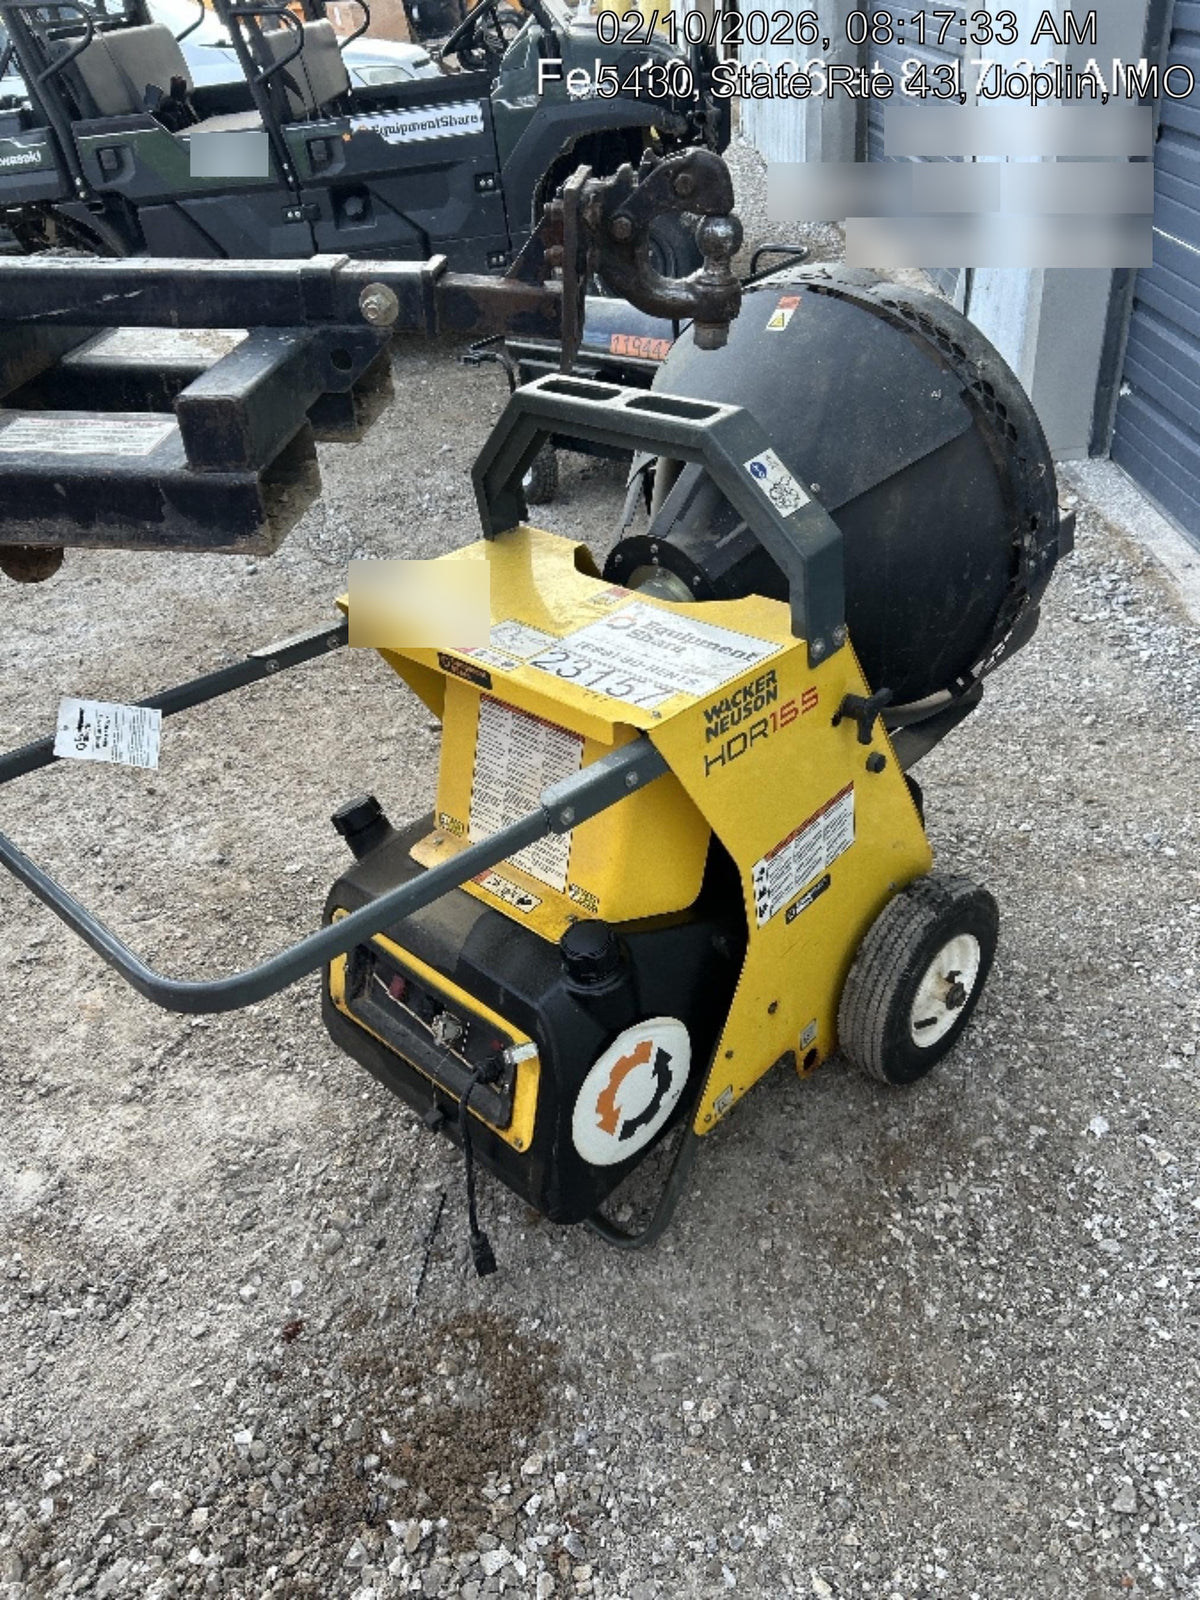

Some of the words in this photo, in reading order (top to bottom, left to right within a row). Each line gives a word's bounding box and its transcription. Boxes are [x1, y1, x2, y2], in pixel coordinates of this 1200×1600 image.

[640, 620, 759, 662] Equipment
[528, 650, 676, 705] 23157
[703, 669, 778, 724] WACKER
[703, 685, 819, 778] HDR155
[705, 684, 778, 744] NEUSON
